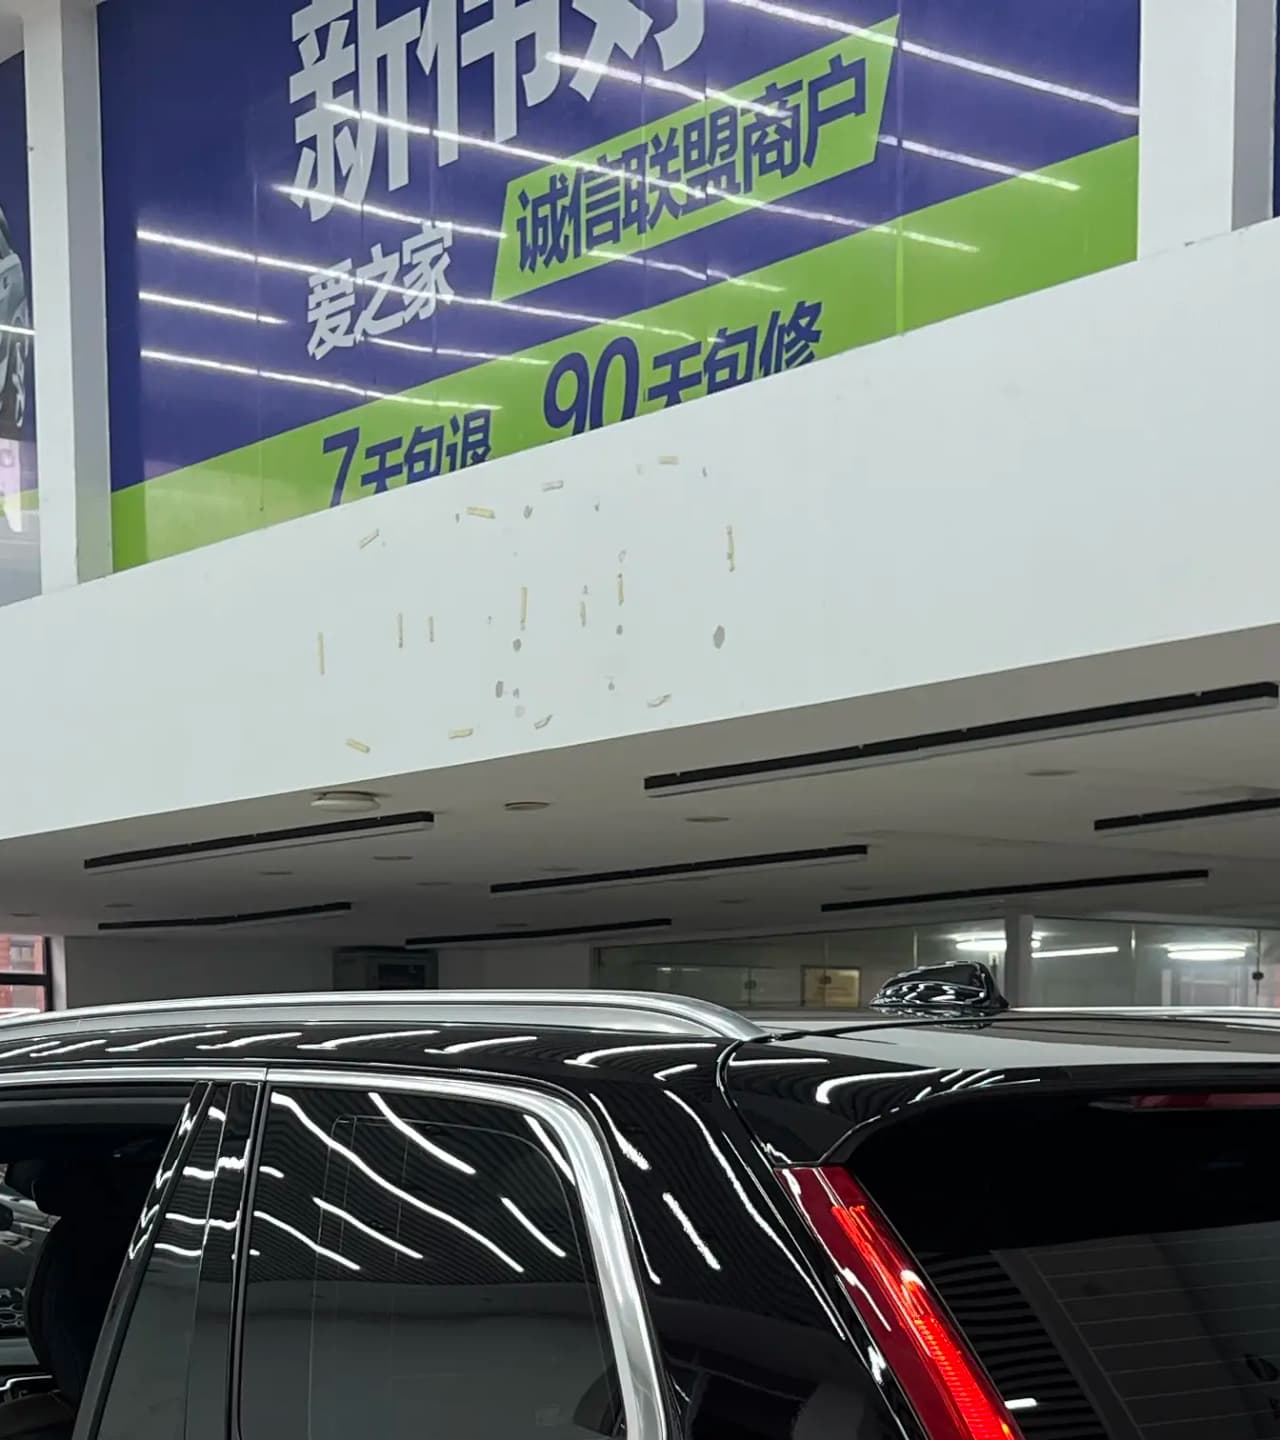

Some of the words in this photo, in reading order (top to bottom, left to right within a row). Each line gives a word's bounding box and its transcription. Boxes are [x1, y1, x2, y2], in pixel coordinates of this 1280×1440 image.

[516, 55, 865, 273] 诚信联盟商户
[306, 221, 454, 360] 爱之家
